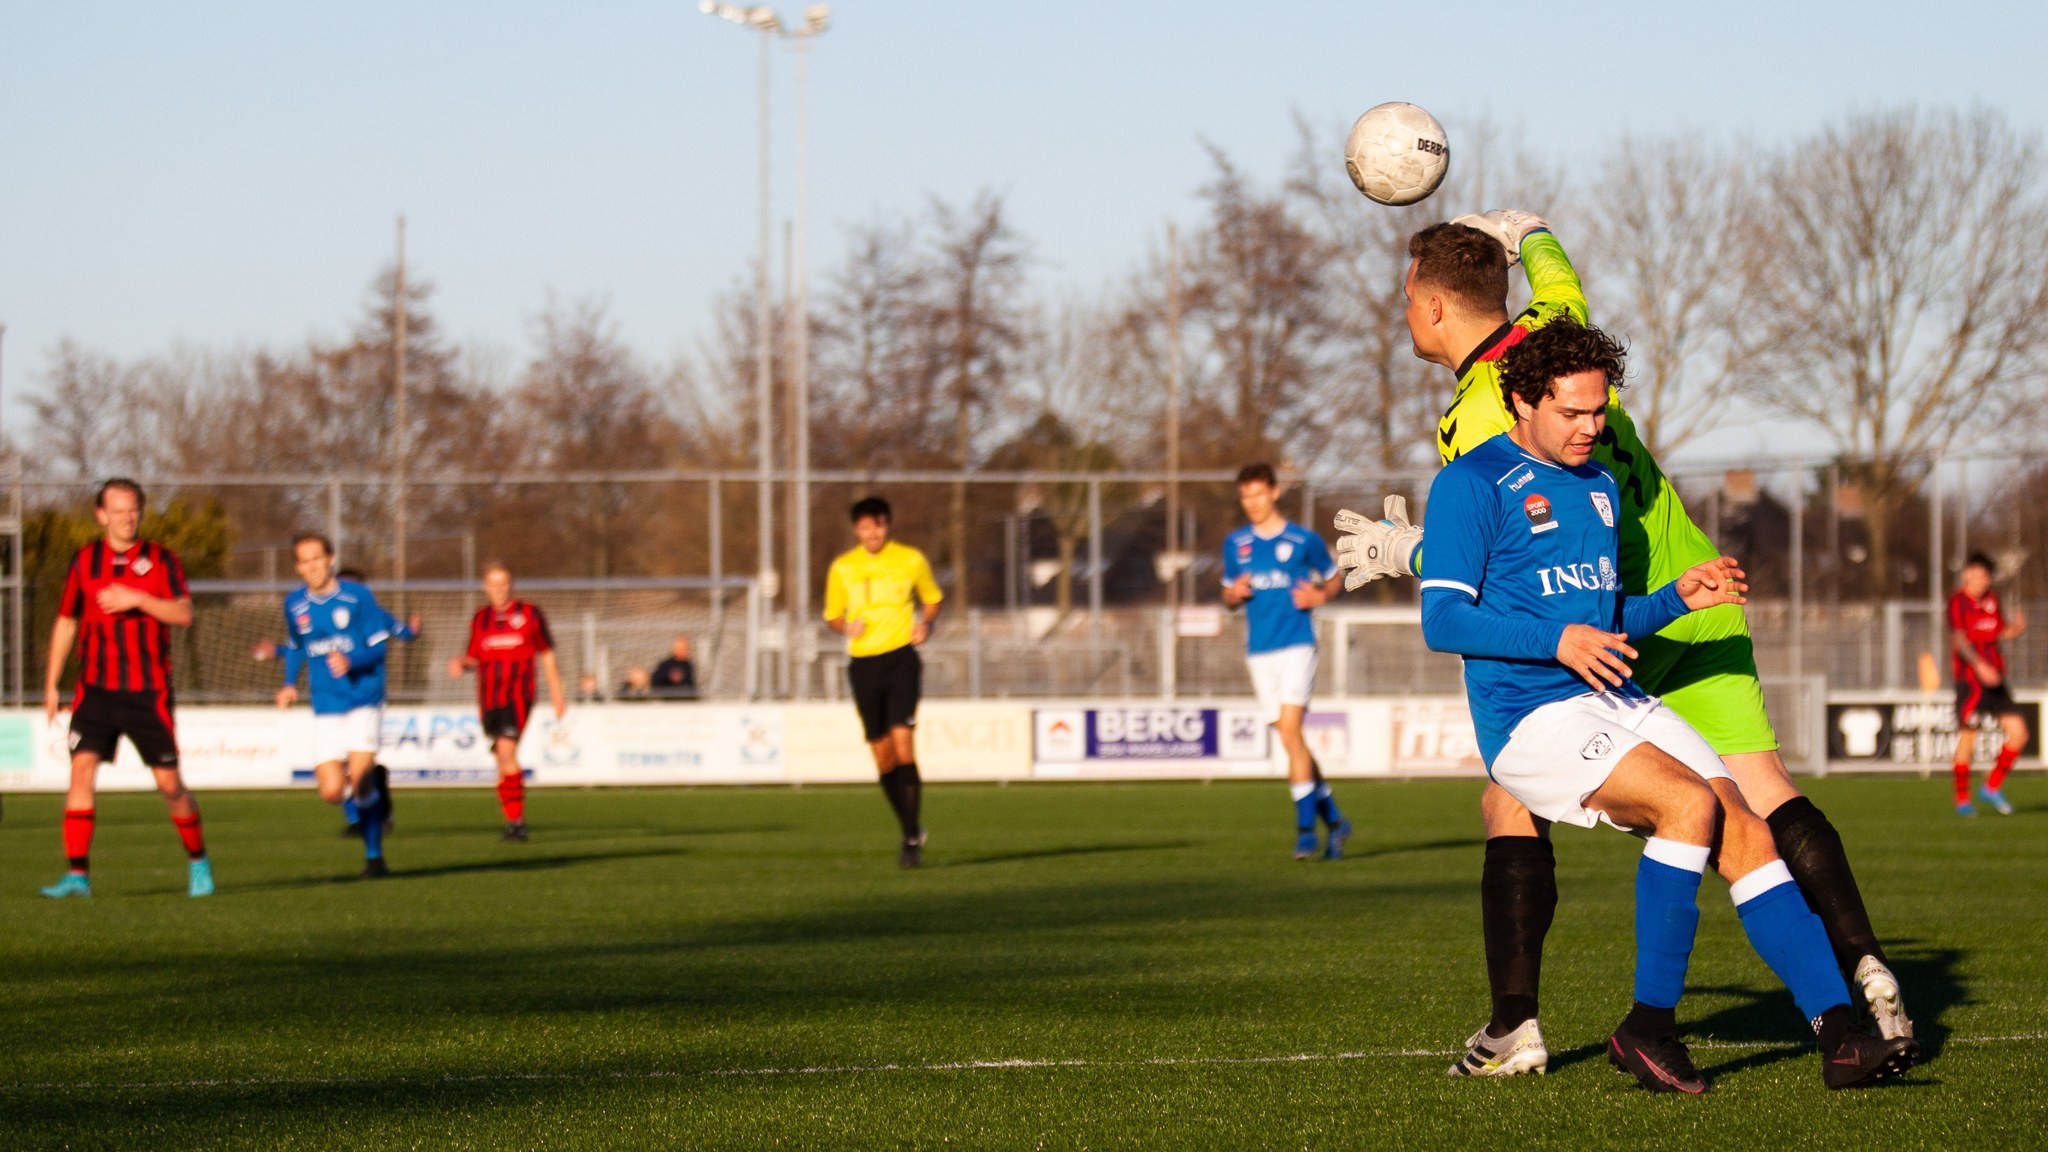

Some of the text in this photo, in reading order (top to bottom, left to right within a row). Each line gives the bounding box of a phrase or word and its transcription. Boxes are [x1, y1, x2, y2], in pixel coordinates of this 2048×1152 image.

[1508, 469, 1535, 492] hummel
[1526, 500, 1545, 511] SPORT
[1530, 507, 1547, 516] 2000
[1335, 514, 1360, 526] ELITE
[1537, 563, 1601, 596] ING
[1095, 708, 1205, 743] BERG
